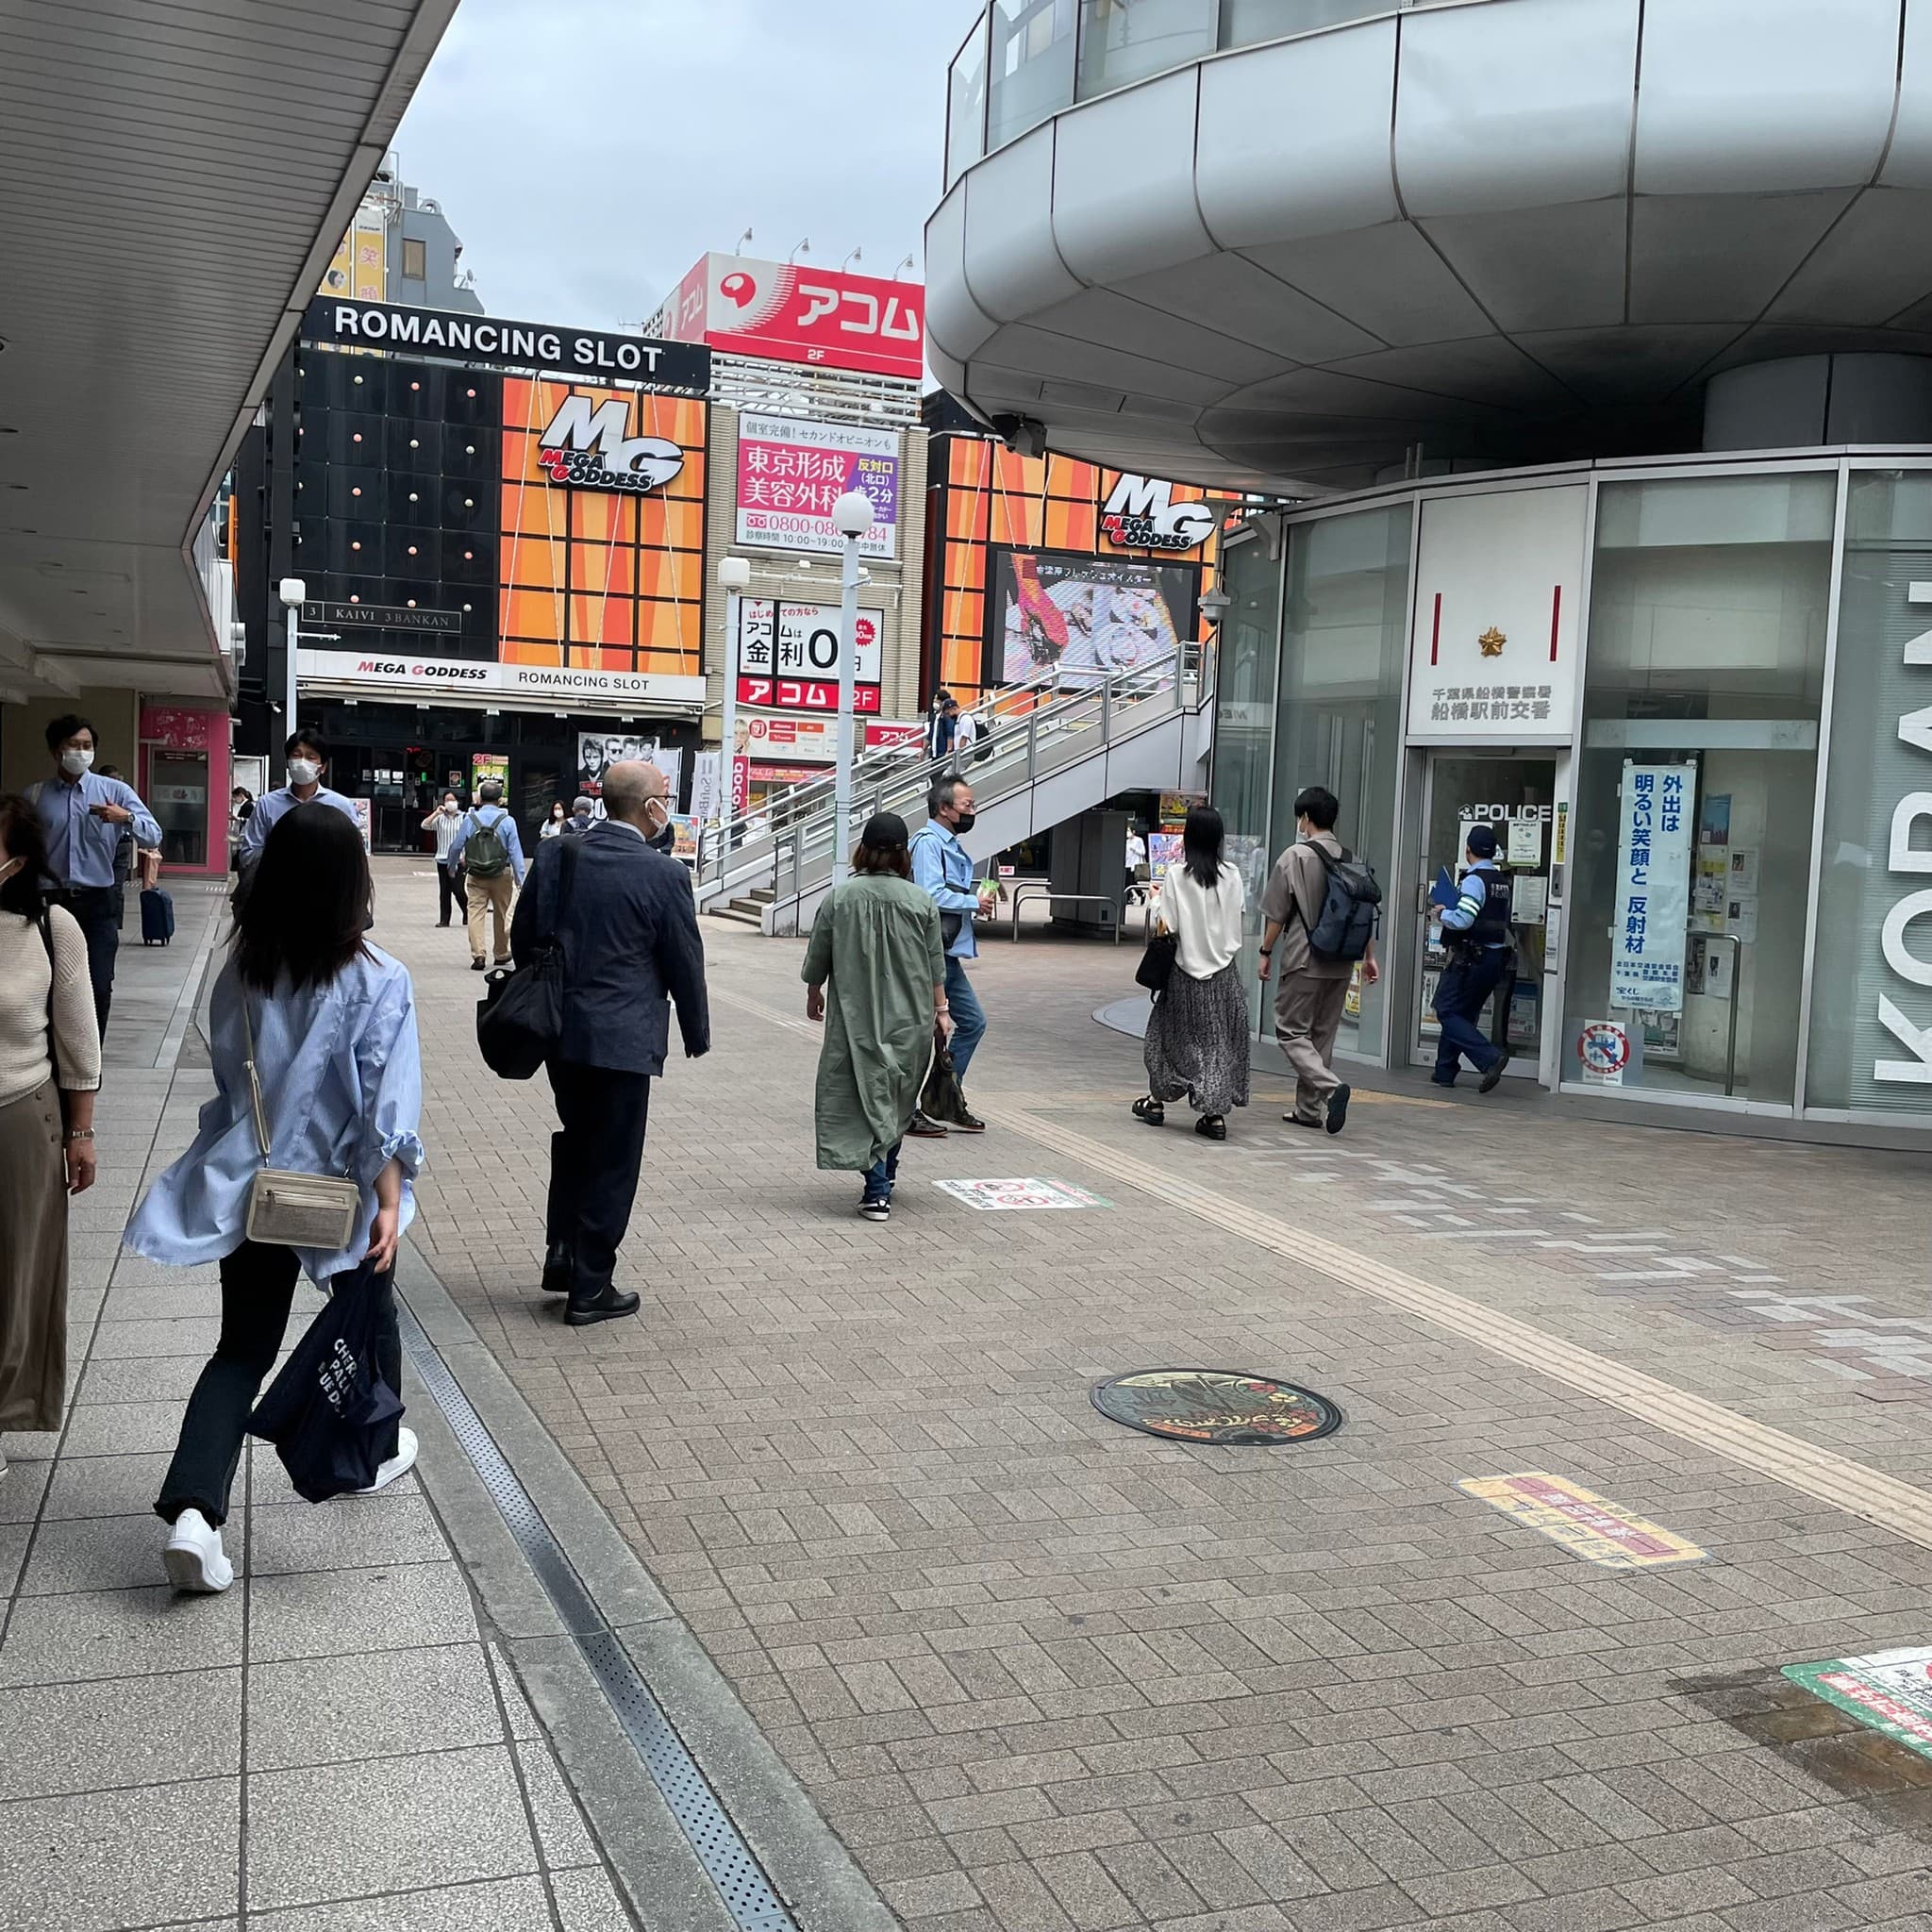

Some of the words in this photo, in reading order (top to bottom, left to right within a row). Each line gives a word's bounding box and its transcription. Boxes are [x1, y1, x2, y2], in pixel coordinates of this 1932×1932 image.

[681, 283, 704, 331] アコム
[797, 284, 920, 341] アコム
[334, 305, 562, 361] ROMANCING
[574, 338, 663, 373] SLOT
[808, 349, 825, 360] 2F
[539, 449, 608, 471] MEGA
[745, 445, 846, 484] 東京形成
[858, 458, 893, 474] 反対口
[551, 465, 654, 491] GODDESS
[1102, 515, 1154, 533] MEGA
[1111, 530, 1192, 551] GODDESS
[309, 607, 316, 616] 3
[747, 622, 802, 638] アコムは
[358, 661, 407, 675] MEGA
[411, 665, 488, 679] GODDESS
[519, 672, 608, 688] ROMANCING
[613, 678, 649, 691] SLOT
[748, 680, 826, 706] アコム
[852, 691, 873, 707] 2F
[1431, 700, 1551, 721] 船橋駅前交番
[1474, 804, 1552, 823] POLICE
[1661, 774, 1683, 832] 外出は
[1630, 774, 1655, 885] 明るい笑顔と
[1624, 896, 1647, 954] 反射材
